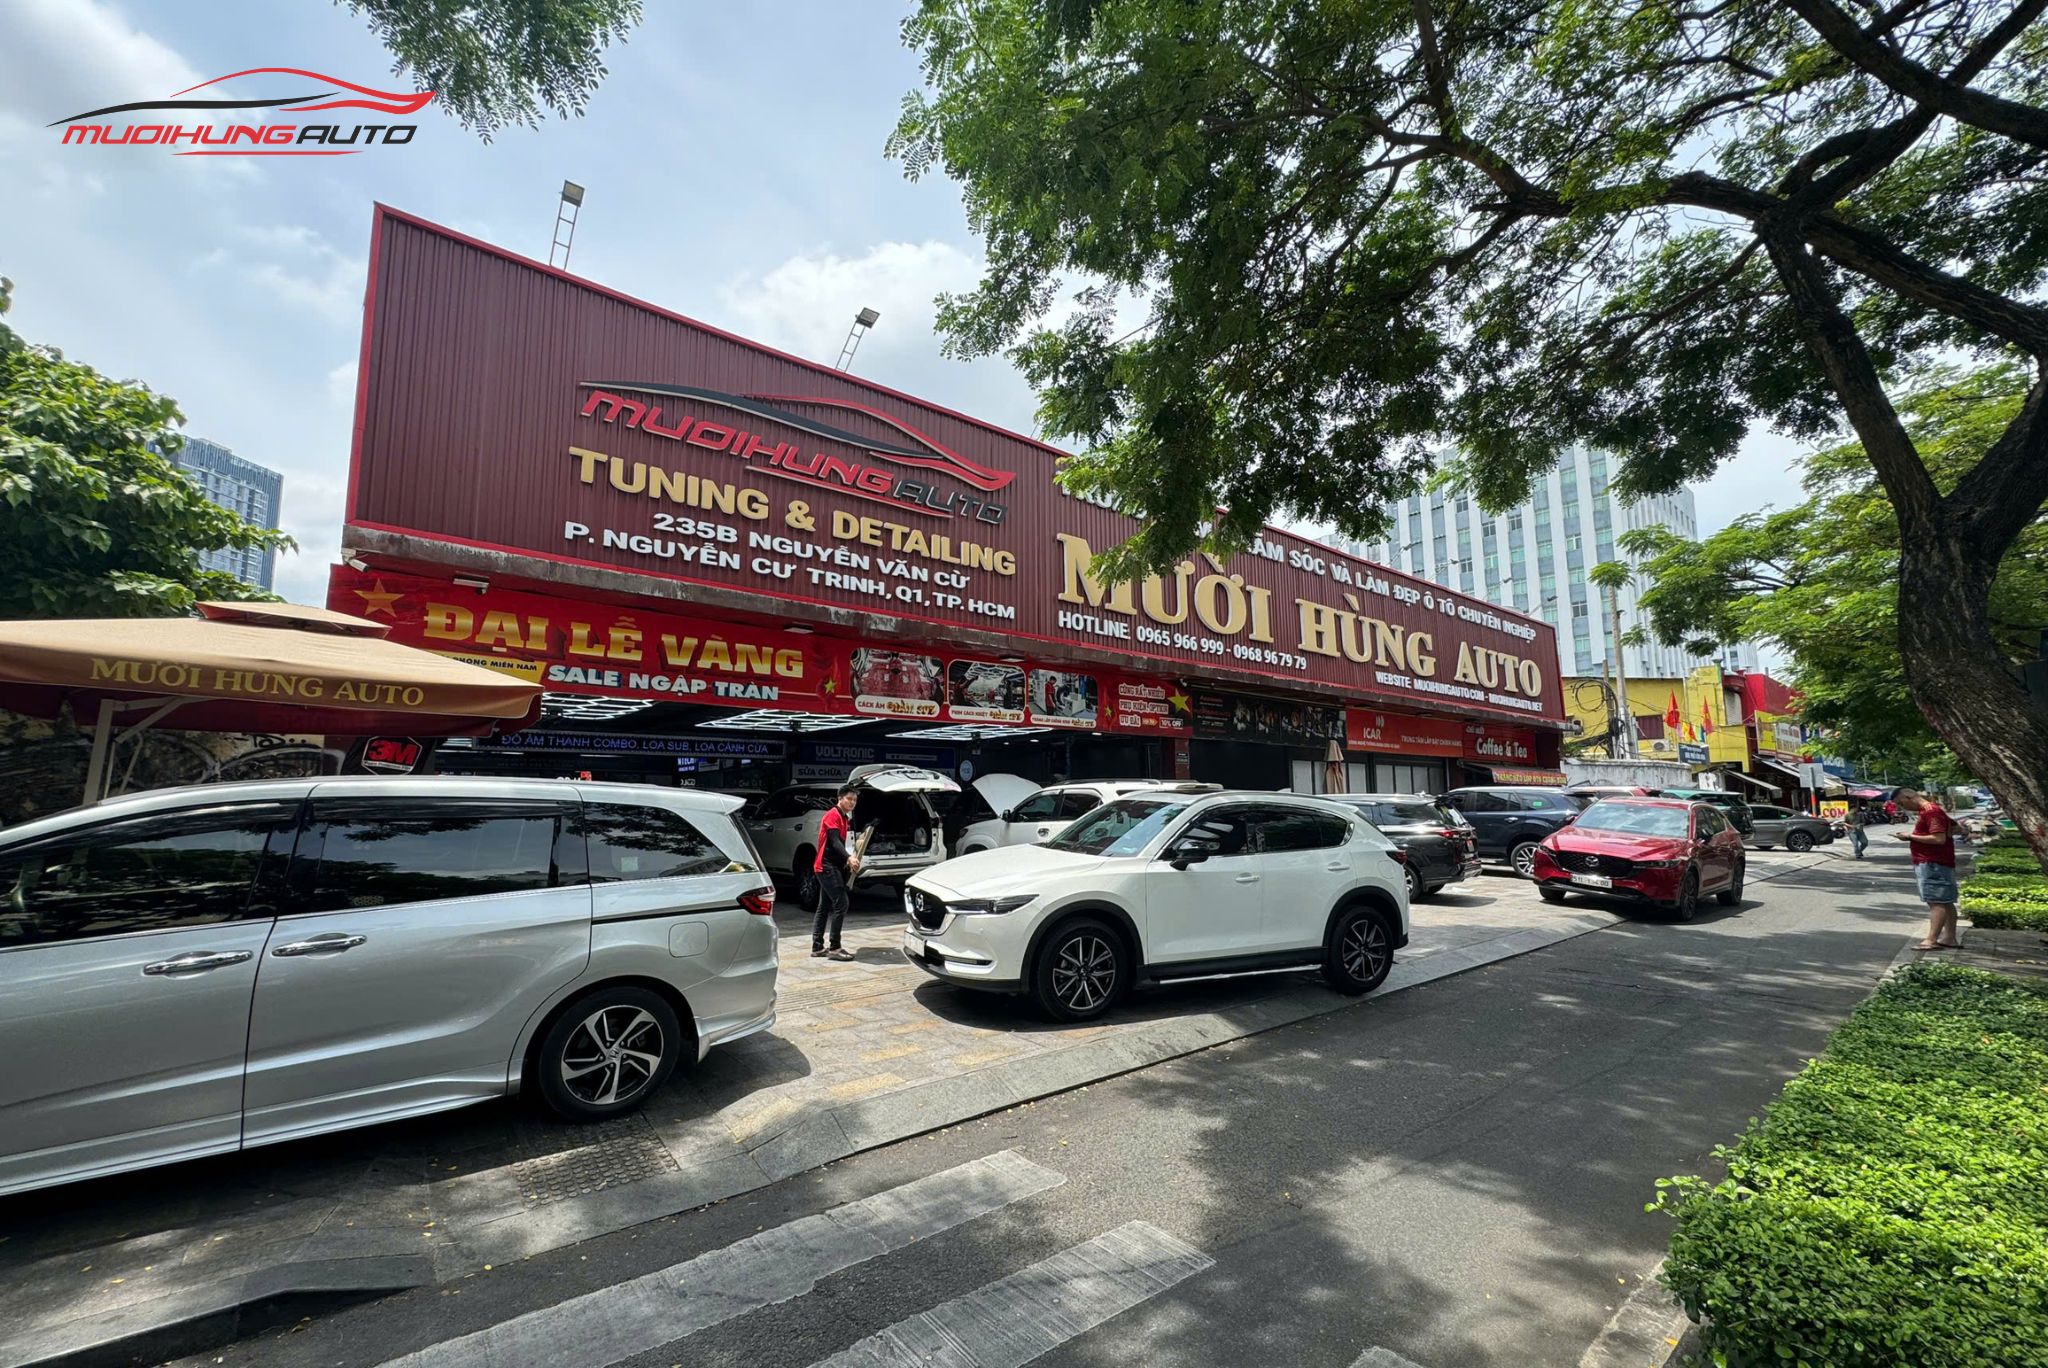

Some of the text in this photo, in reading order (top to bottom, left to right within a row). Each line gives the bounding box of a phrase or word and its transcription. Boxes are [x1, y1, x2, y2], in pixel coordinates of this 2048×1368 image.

[568, 446, 1016, 576] TUNING & DETAILING
[564, 520, 595, 544] P.
[603, 528, 740, 570] NGUYỄN
[752, 557, 797, 579] CƯ
[653, 513, 971, 589] 235B NGUYỄN VĂN CỪ
[1289, 548, 1325, 576] SÓC
[1330, 560, 1353, 585] VÀ
[1355, 570, 1390, 597] LÀM
[1392, 584, 1421, 608] ĐẸP
[1423, 591, 1434, 610] Ô
[1437, 598, 1456, 617] TÔ
[1457, 605, 1502, 631] CHUYÊN
[1502, 620, 1536, 644] NGHIỆP
[424, 602, 804, 678] ĐẠI LỄ VÀNG
[1136, 625, 1171, 646] 0965
[1173, 633, 1198, 651] 966
[1200, 638, 1224, 656] 999
[1233, 644, 1263, 663] 0968
[1264, 650, 1278, 665] 96
[1279, 652, 1293, 667] 79
[1294, 655, 1307, 670] 79
[1295, 593, 1437, 678] HÙNG
[1454, 641, 1542, 698] AUTO
[517, 663, 537, 672] NAM
[548, 665, 779, 701] SALE NGẬP TRÀN
[333, 681, 425, 706] AUTO
[367, 740, 418, 765] 3M
[548, 736, 590, 748] THANH
[642, 740, 666, 750] LOA
[695, 742, 716, 752] LOA
[1363, 727, 1382, 740] ICAR
[1476, 737, 1503, 756] Coffee
[1513, 742, 1528, 758] Tea
